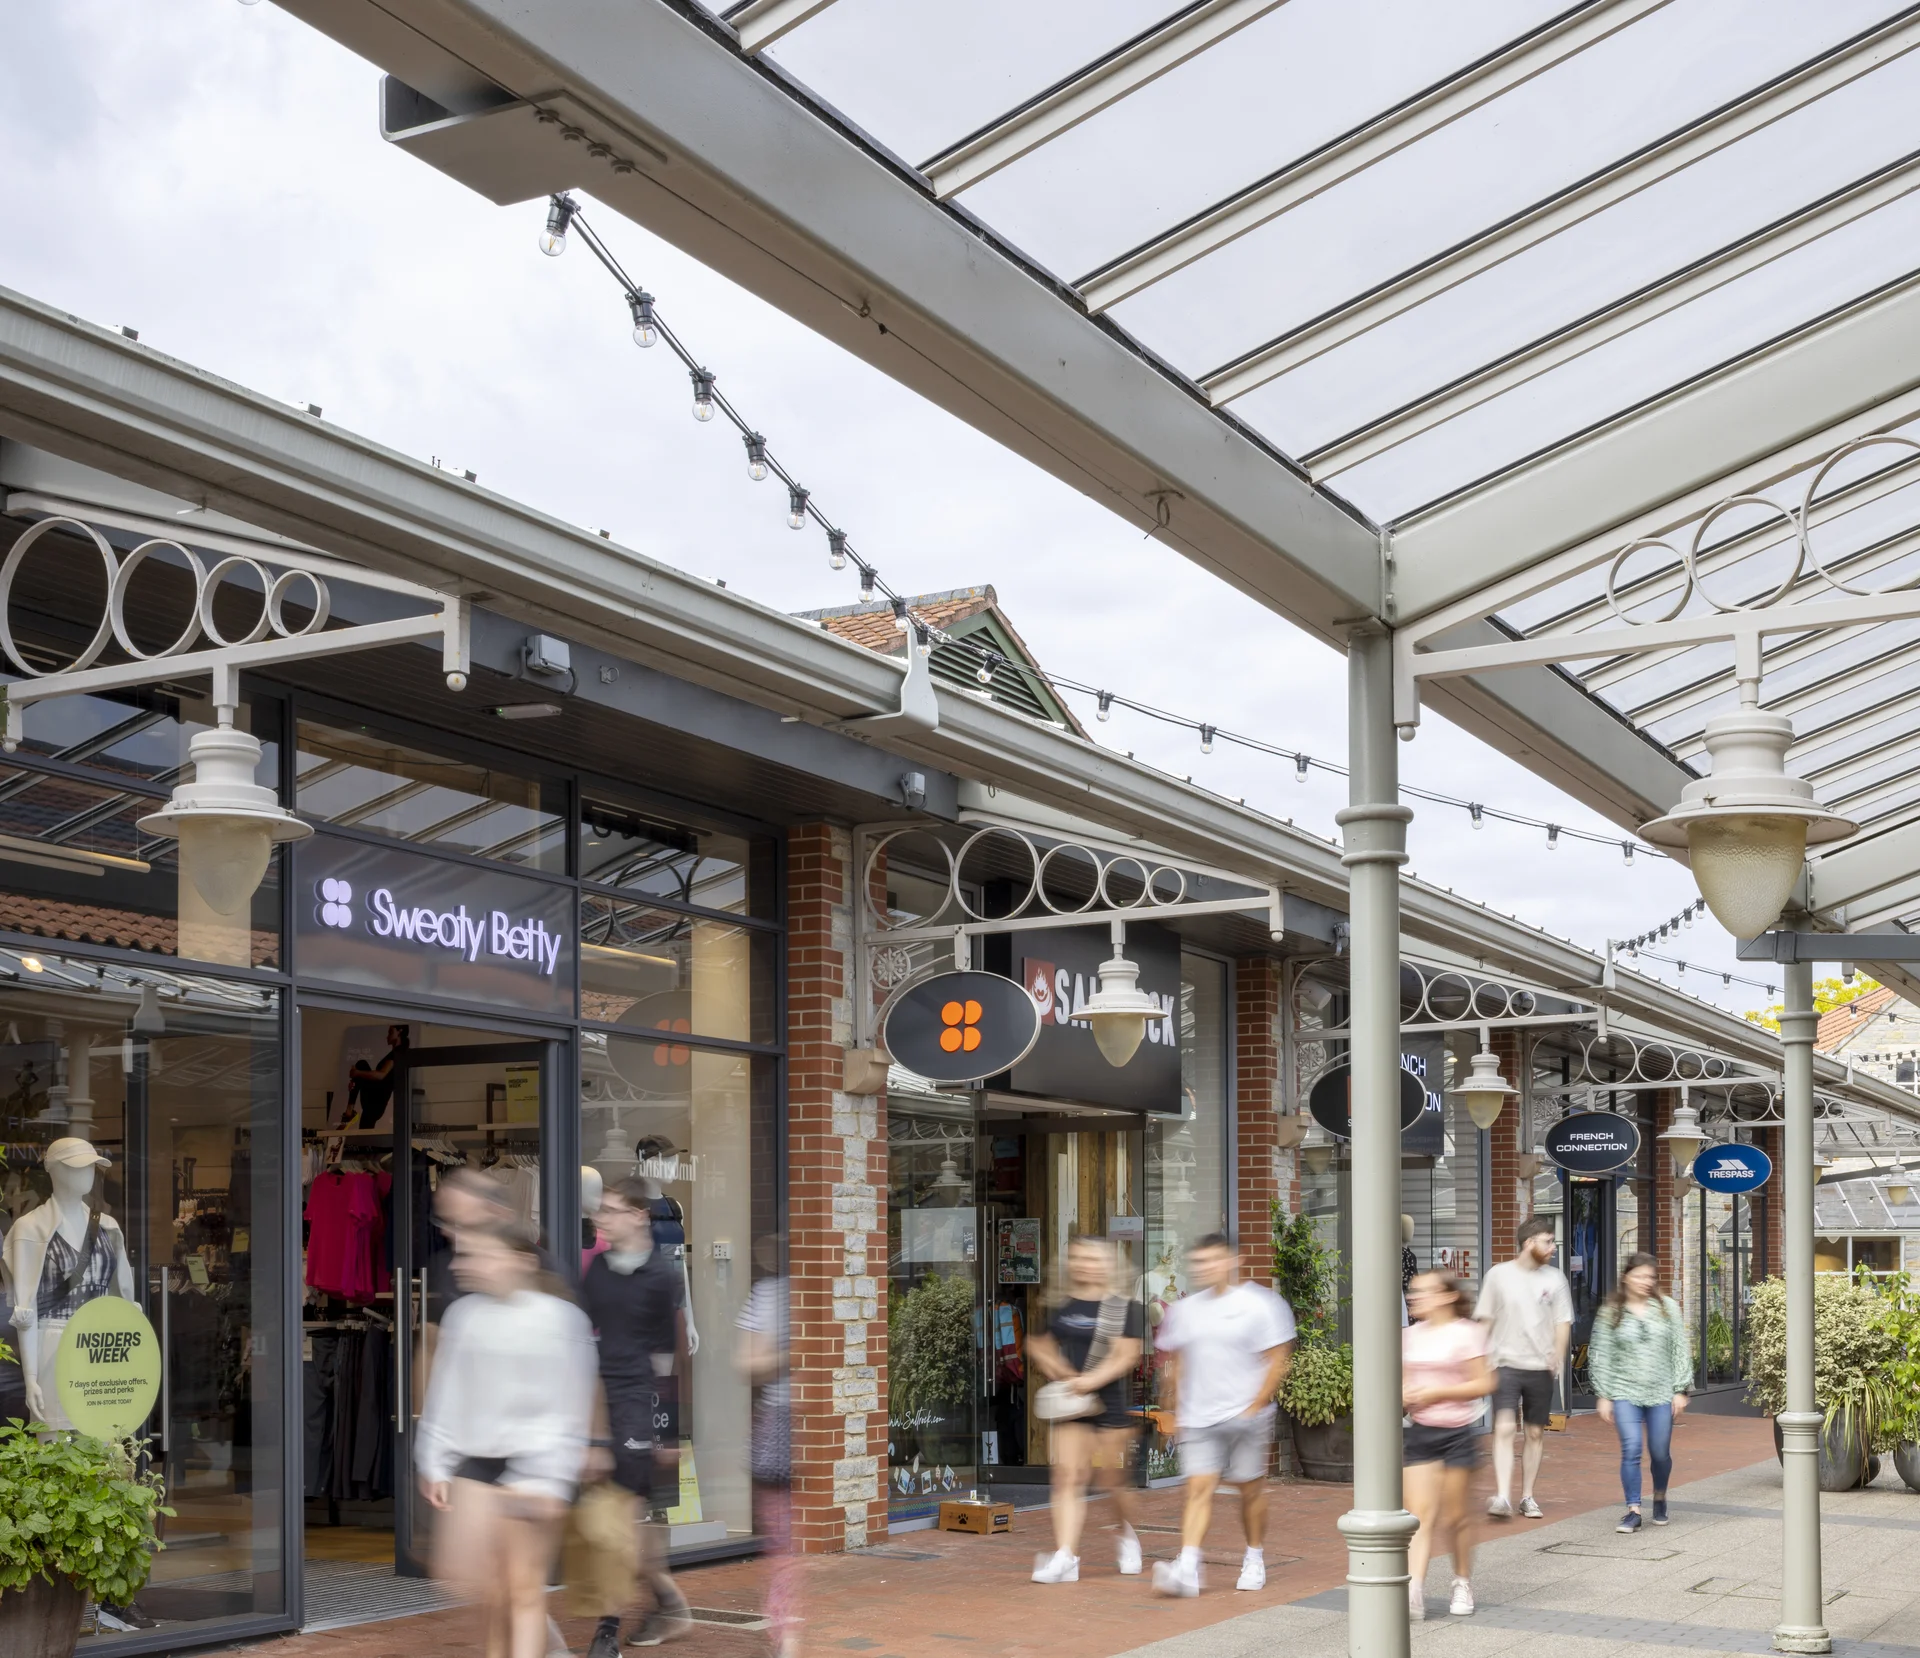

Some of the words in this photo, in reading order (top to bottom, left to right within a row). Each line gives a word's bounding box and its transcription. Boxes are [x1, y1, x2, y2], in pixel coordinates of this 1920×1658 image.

[369, 888, 485, 962] Sweaty
[488, 910, 562, 975] Betty
[1569, 1132, 1614, 1141] FRENCH
[1556, 1143, 1628, 1152] CONNECTION
[1707, 1170, 1755, 1179] TRESPASS
[76, 1332, 142, 1348] INSIDERS
[89, 1347, 131, 1364] WEEK
[75, 1380, 90, 1389] days
[98, 1379, 127, 1387] exclusive
[128, 1378, 148, 1386] offers,
[84, 1387, 103, 1397] prizes
[103, 1387, 116, 1395] and
[117, 1386, 135, 1395] perks
